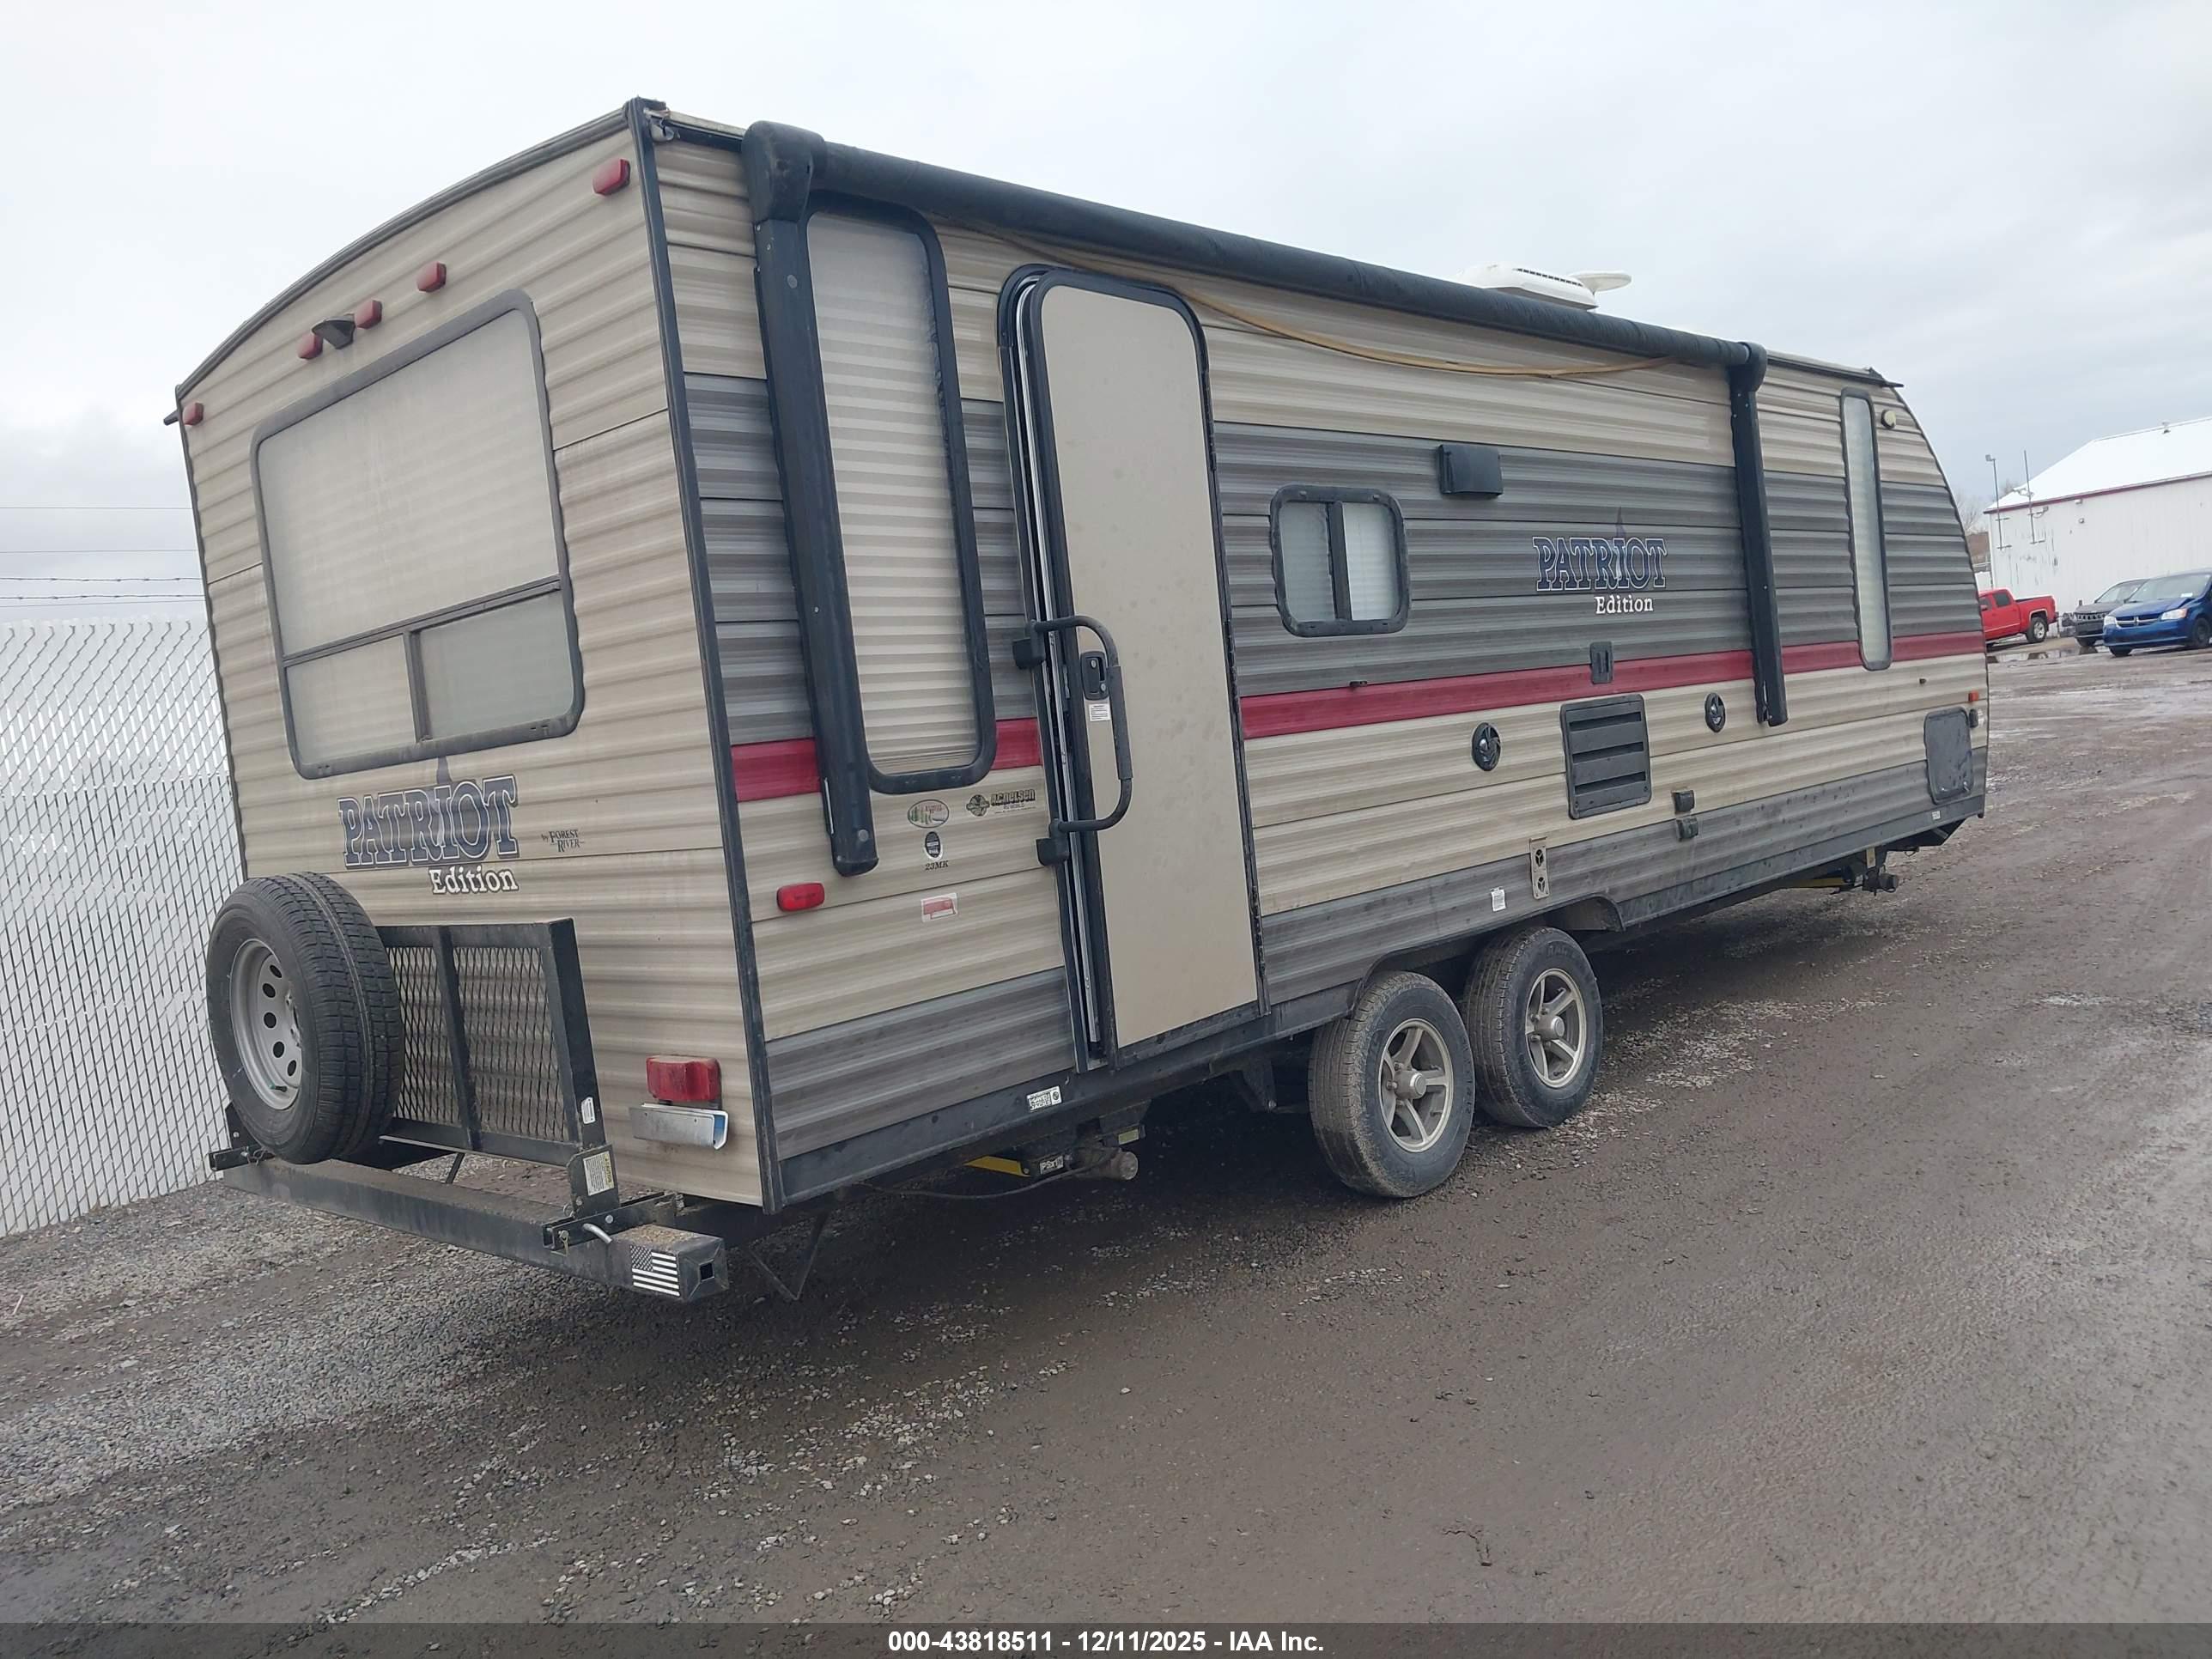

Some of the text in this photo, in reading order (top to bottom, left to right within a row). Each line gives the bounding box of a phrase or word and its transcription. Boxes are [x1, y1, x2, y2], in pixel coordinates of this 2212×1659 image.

[1532, 537, 1668, 592] PATRIOT
[1595, 595, 1653, 614] Edition
[337, 775, 520, 868] PATRIOT
[549, 829, 579, 843] FOREST
[557, 839, 580, 852] RIVER
[428, 864, 519, 895] Edition
